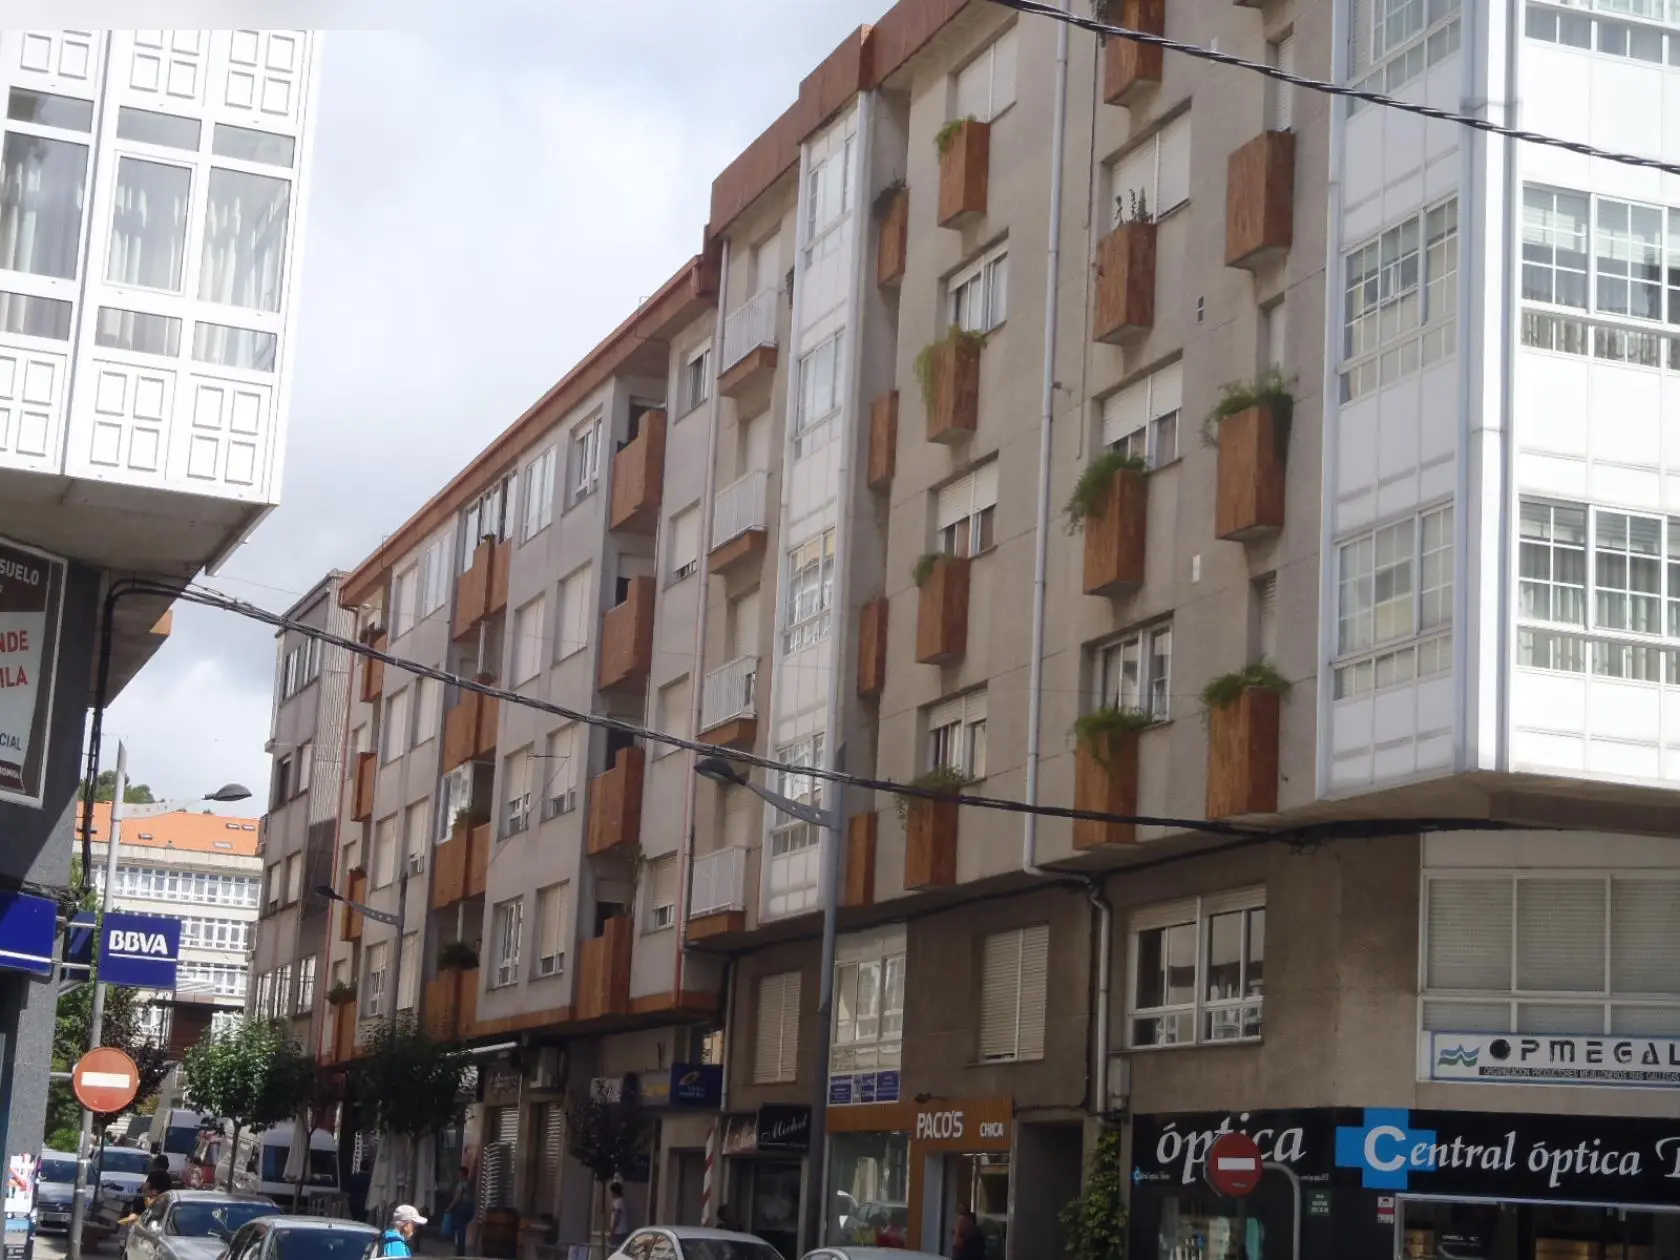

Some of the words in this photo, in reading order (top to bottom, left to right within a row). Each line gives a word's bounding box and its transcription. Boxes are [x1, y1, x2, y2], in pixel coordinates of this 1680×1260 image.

[108, 930, 168, 955] BBVA
[917, 1110, 963, 1139] PACO'S
[1156, 1112, 1307, 1184] óptca
[1364, 1125, 1516, 1172] Central
[1527, 1138, 1642, 1188] óptica
